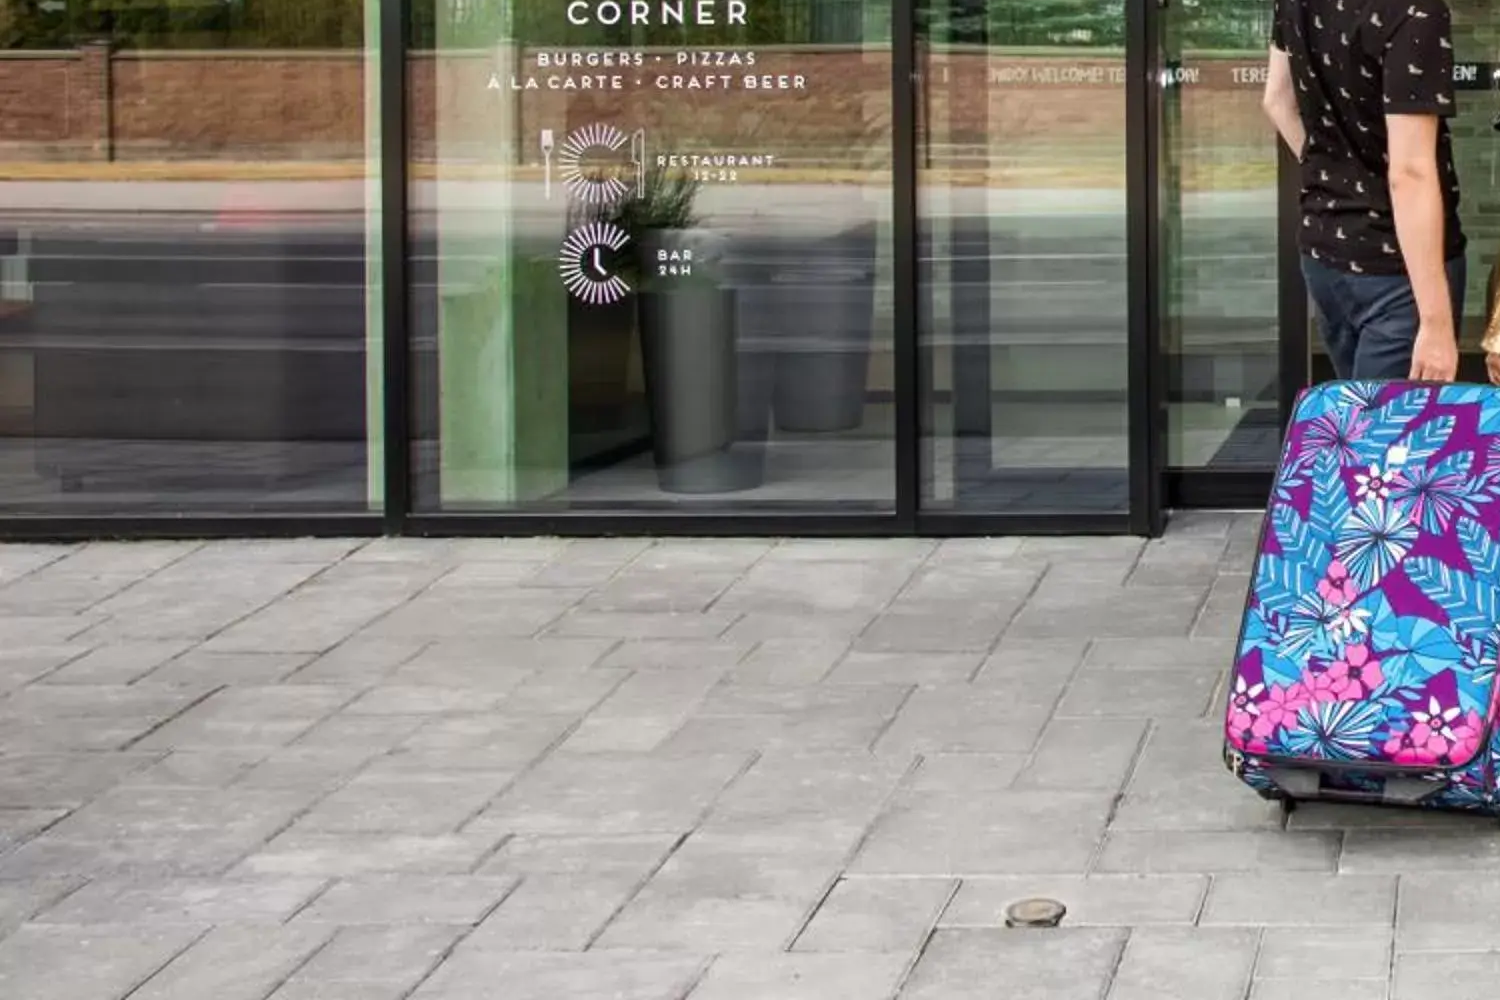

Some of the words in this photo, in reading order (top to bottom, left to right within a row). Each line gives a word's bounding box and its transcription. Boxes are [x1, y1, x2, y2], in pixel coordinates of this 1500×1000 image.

[567, 1, 747, 25] CORNER
[537, 52, 643, 67] BURGERS
[677, 52, 756, 66] PIZZAS
[511, 76, 538, 89] LA
[547, 75, 623, 89] CARTE
[655, 75, 732, 89] CRAFT
[744, 75, 806, 89] BEER
[657, 155, 774, 167] RESTAURANT
[657, 249, 692, 261] BAR
